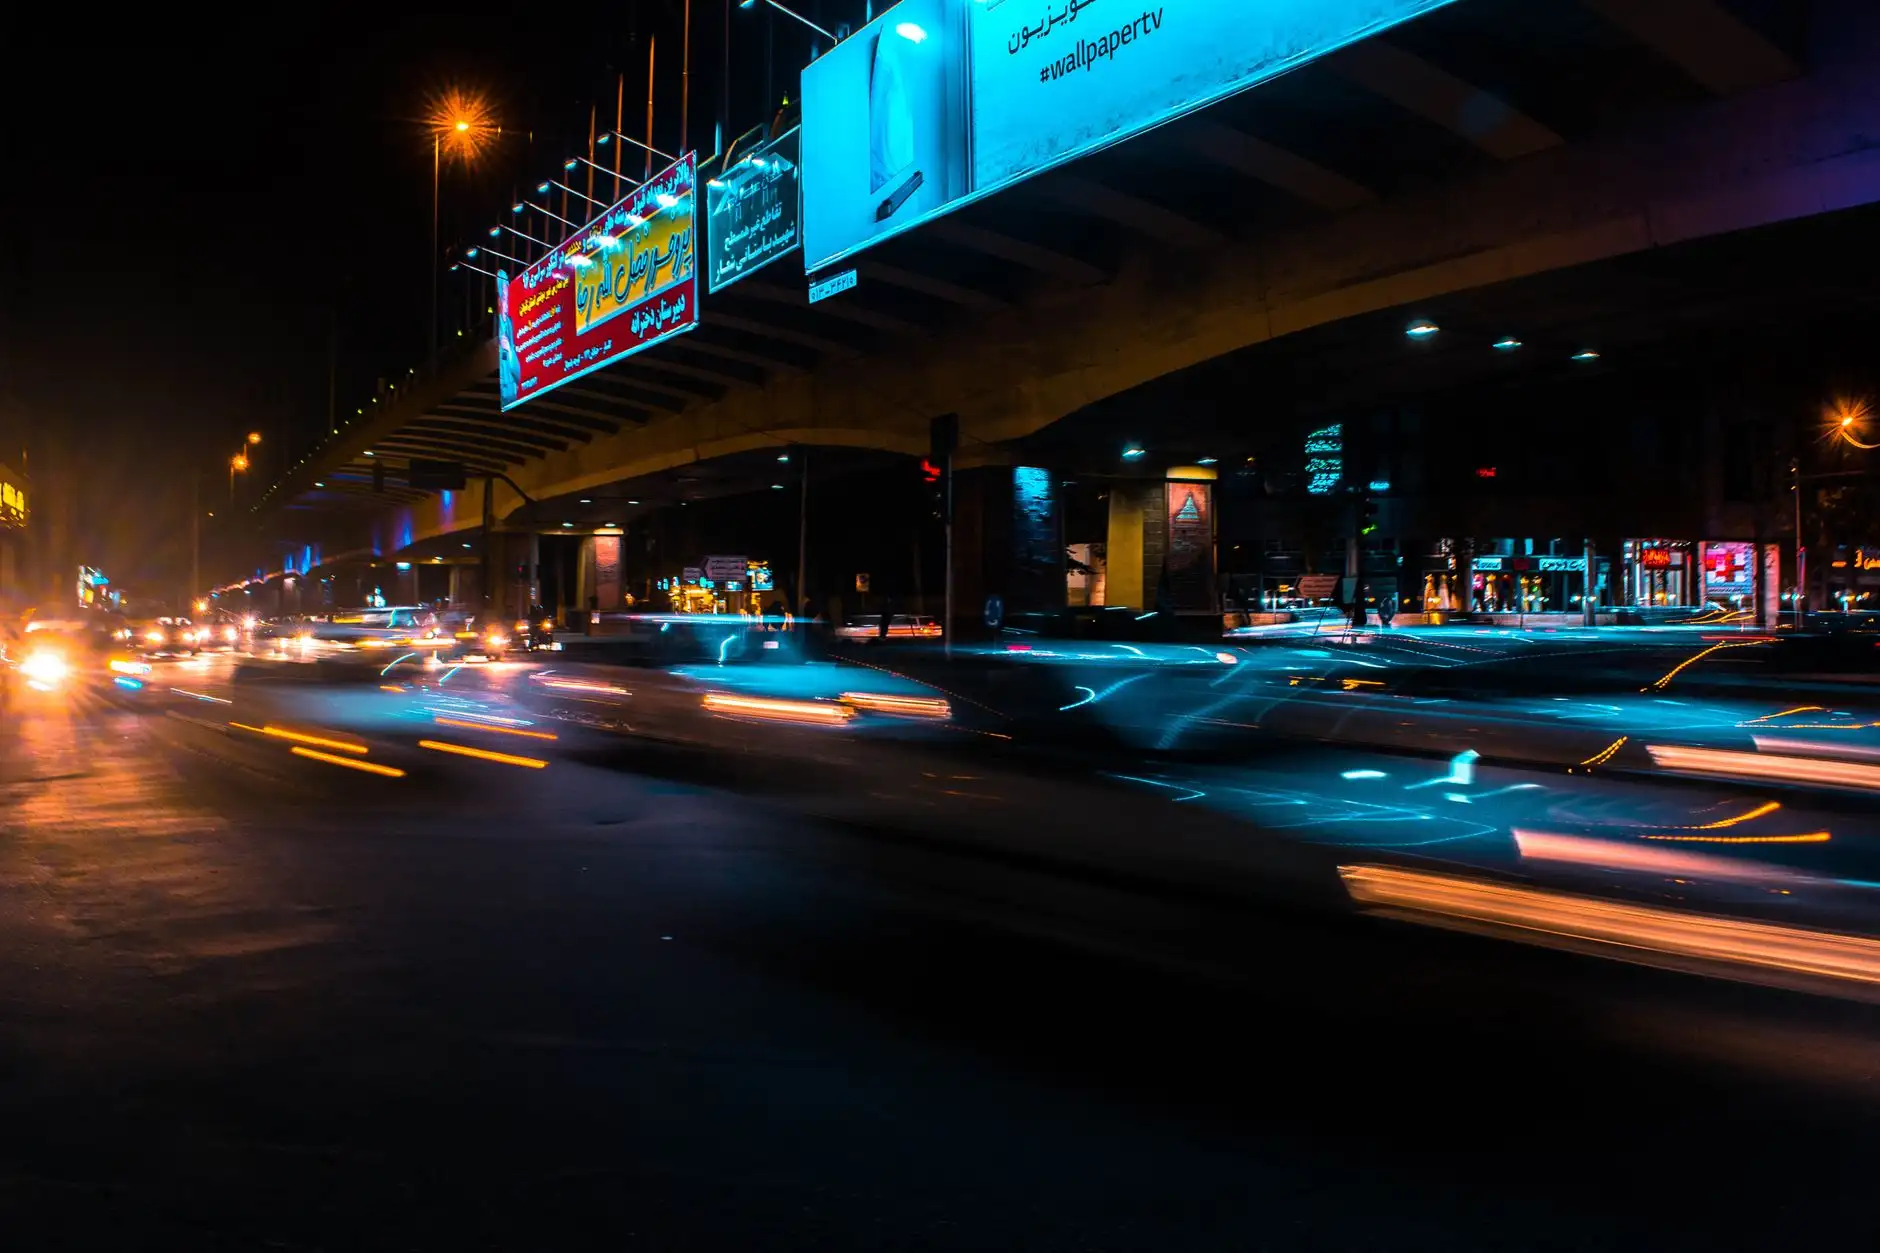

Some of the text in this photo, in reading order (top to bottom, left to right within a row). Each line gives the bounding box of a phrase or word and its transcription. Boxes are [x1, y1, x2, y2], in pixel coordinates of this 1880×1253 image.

[1040, 7, 1163, 84] #wallpapertv
[760, 201, 782, 232] تقاطع
[772, 220, 795, 247] شهید
[614, 221, 649, 304] فضل
[643, 208, 693, 296] پروفسور
[655, 293, 686, 331] دبیرستان
